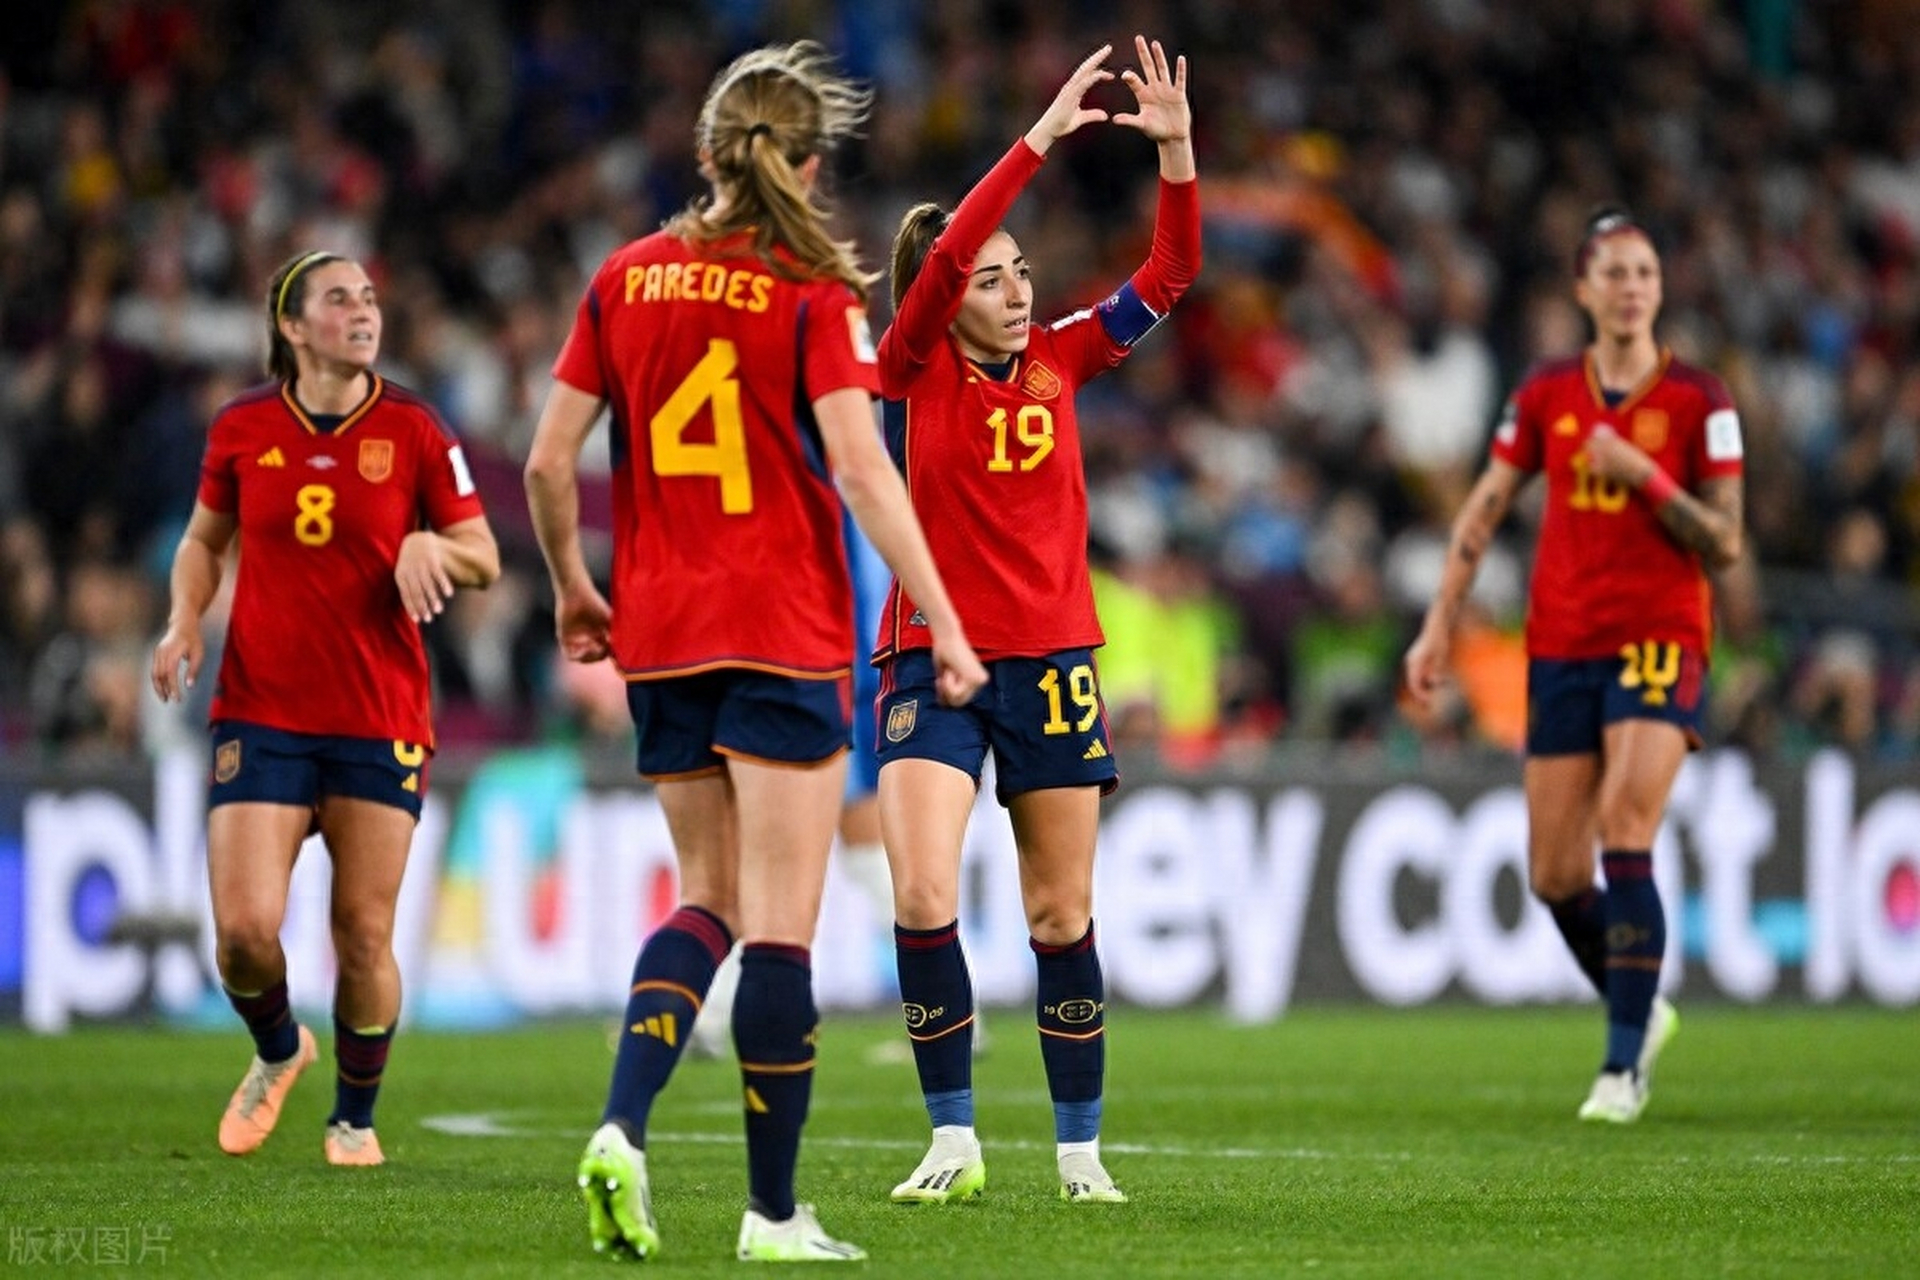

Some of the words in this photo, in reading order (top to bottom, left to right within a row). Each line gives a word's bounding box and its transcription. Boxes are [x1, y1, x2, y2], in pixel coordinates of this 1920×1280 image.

[625, 262, 774, 313] PAREDES
[650, 338, 753, 515] 4
[985, 404, 1055, 472] 19
[295, 484, 335, 546] 8
[1037, 664, 1099, 735] 19
